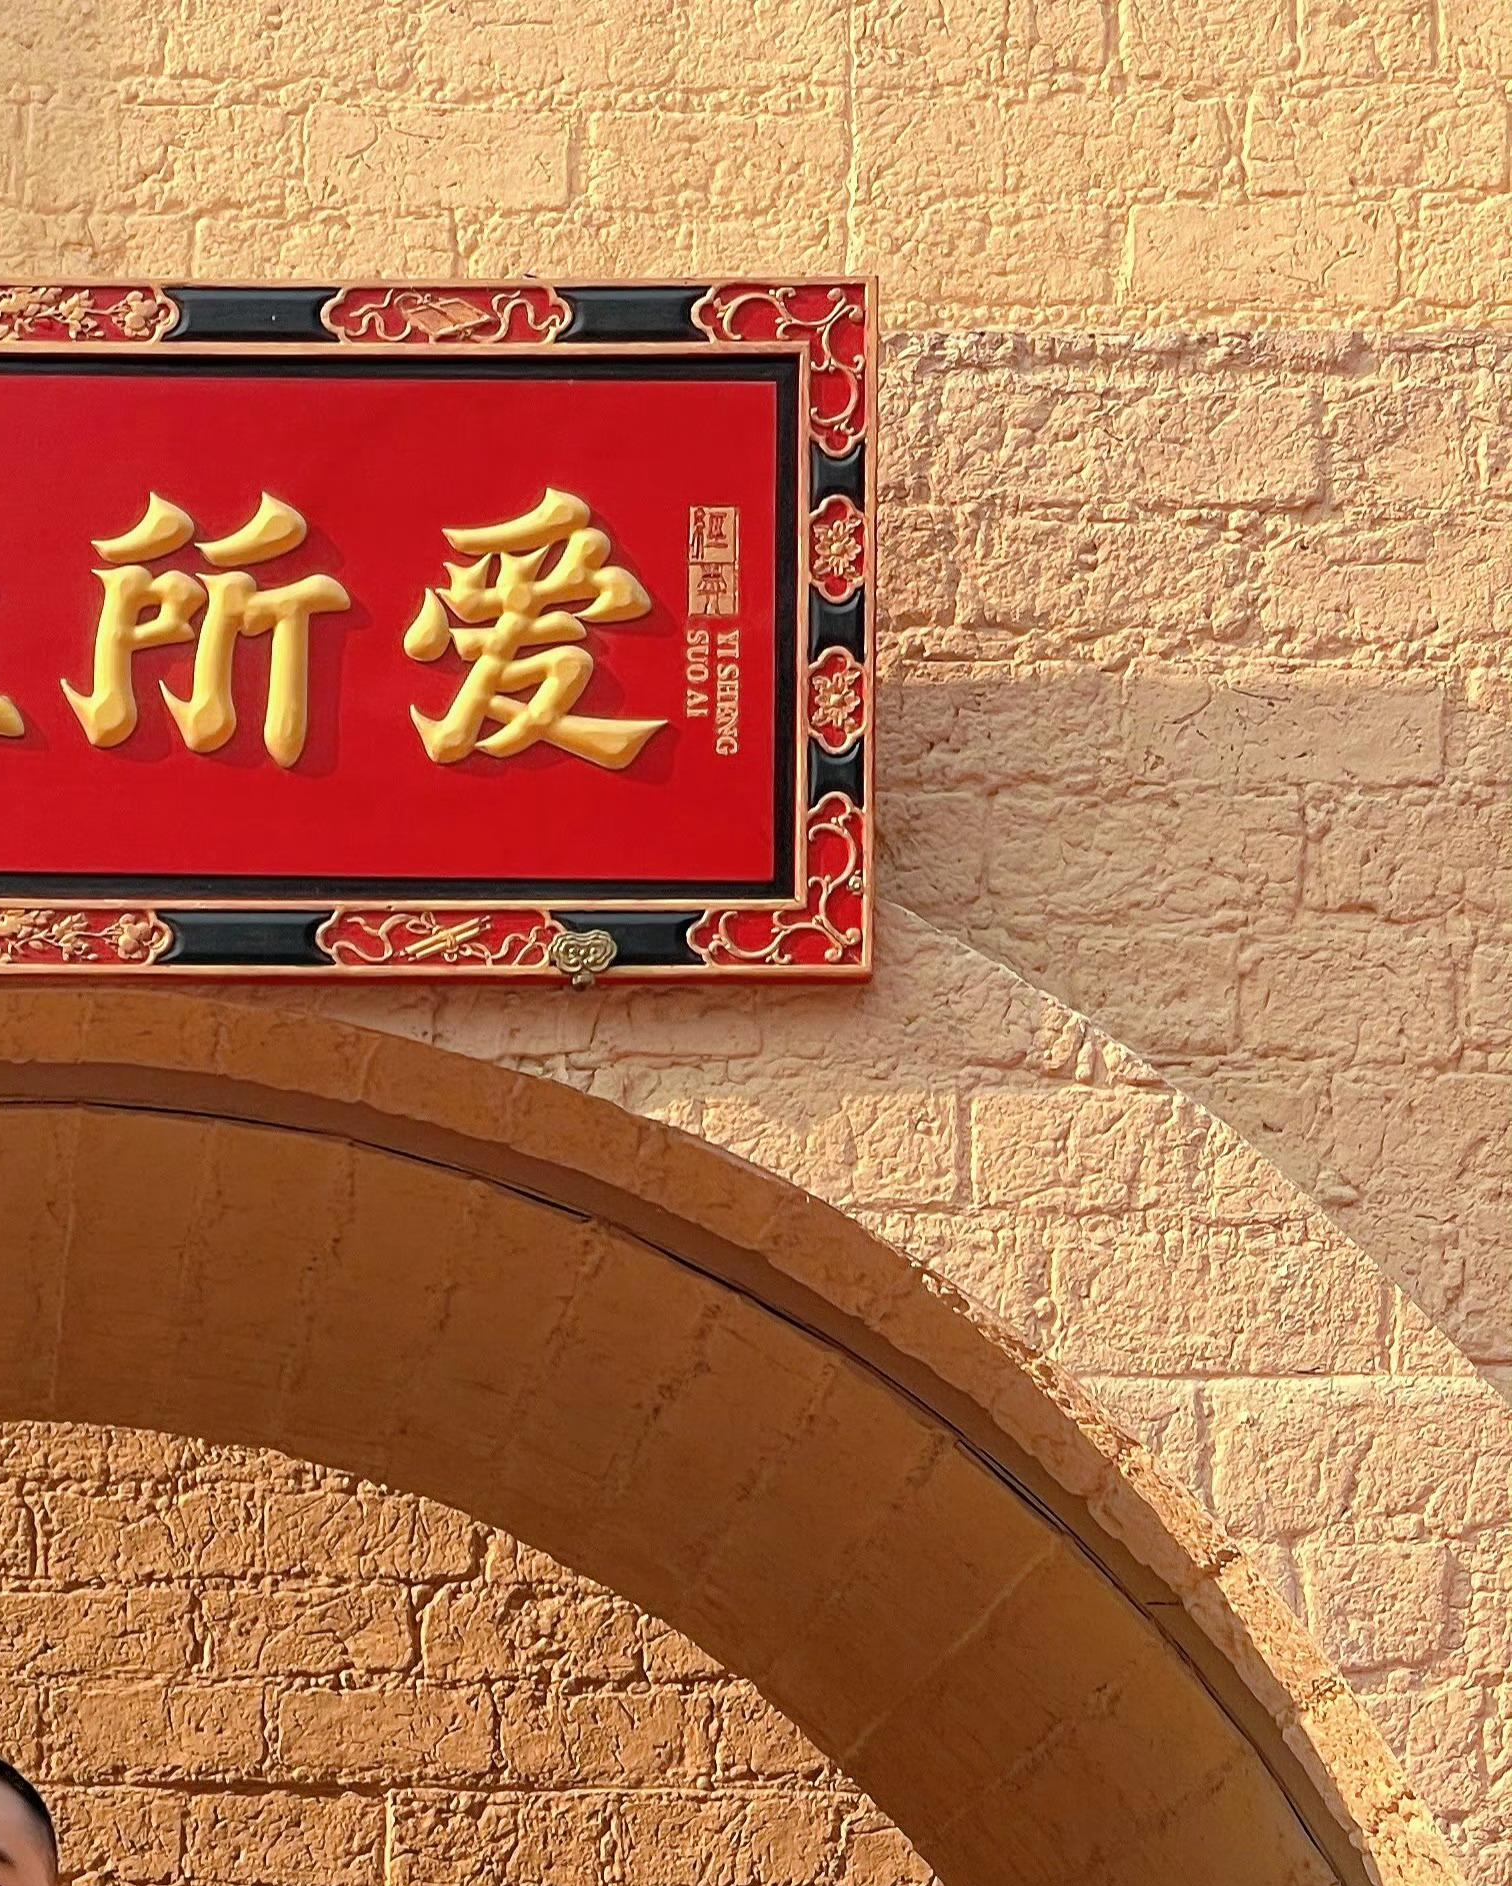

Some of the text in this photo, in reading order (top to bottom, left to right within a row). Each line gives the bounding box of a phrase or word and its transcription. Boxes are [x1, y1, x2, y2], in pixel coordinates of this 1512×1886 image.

[686, 630, 710, 718] SUO AI
[715, 630, 740, 756] YI SHENG
